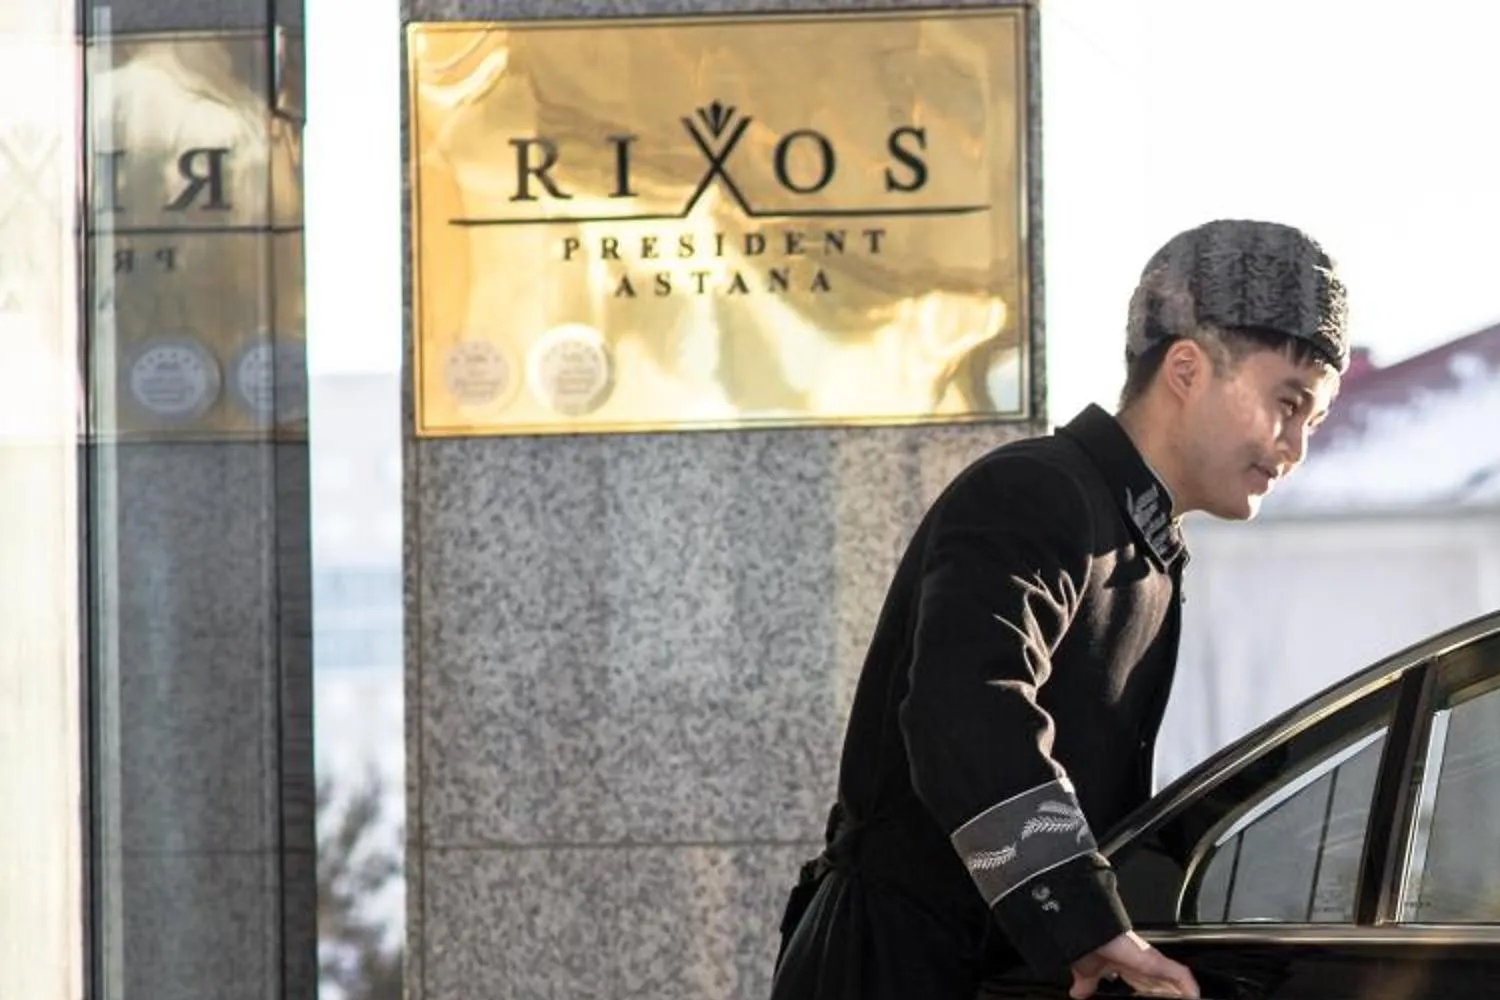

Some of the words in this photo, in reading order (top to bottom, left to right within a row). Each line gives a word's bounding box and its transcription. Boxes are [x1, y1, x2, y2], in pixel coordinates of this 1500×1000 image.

[508, 100, 929, 217] RIXOS
[562, 229, 887, 261] PRESIDENT
[615, 270, 833, 298] ASTANA
